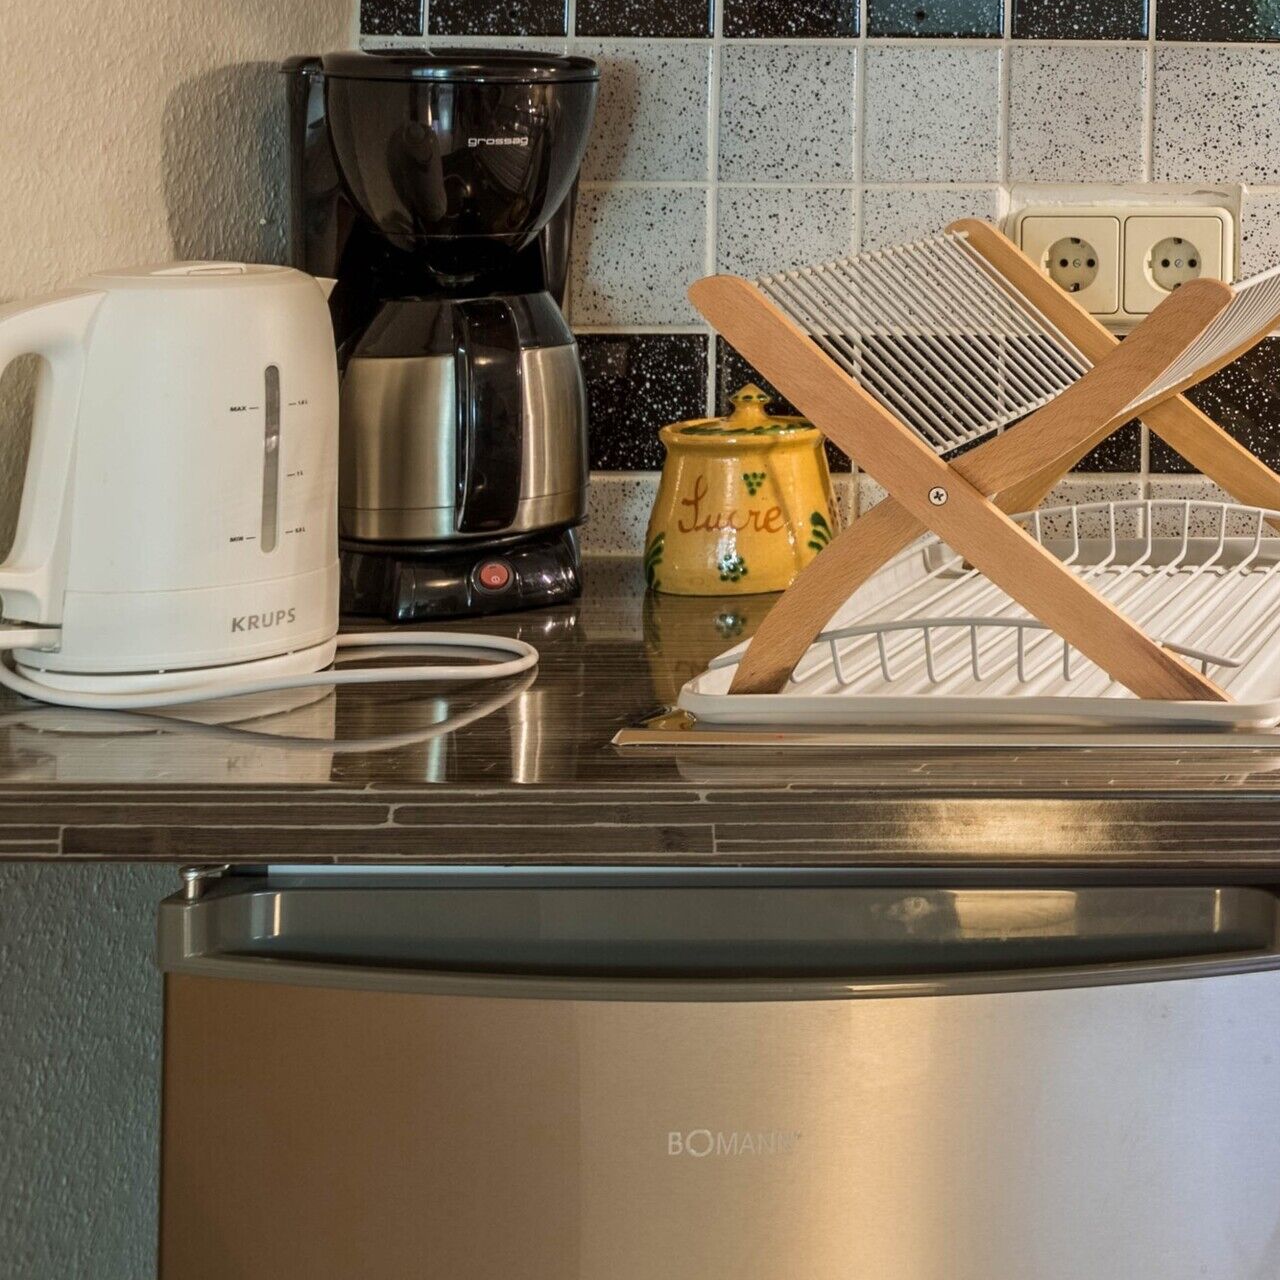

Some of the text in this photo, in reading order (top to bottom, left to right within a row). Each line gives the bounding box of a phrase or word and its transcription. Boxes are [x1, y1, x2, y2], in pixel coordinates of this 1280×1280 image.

[468, 136, 529, 147] grossag
[679, 474, 786, 533] Sucre
[231, 607, 296, 633] KRUPS
